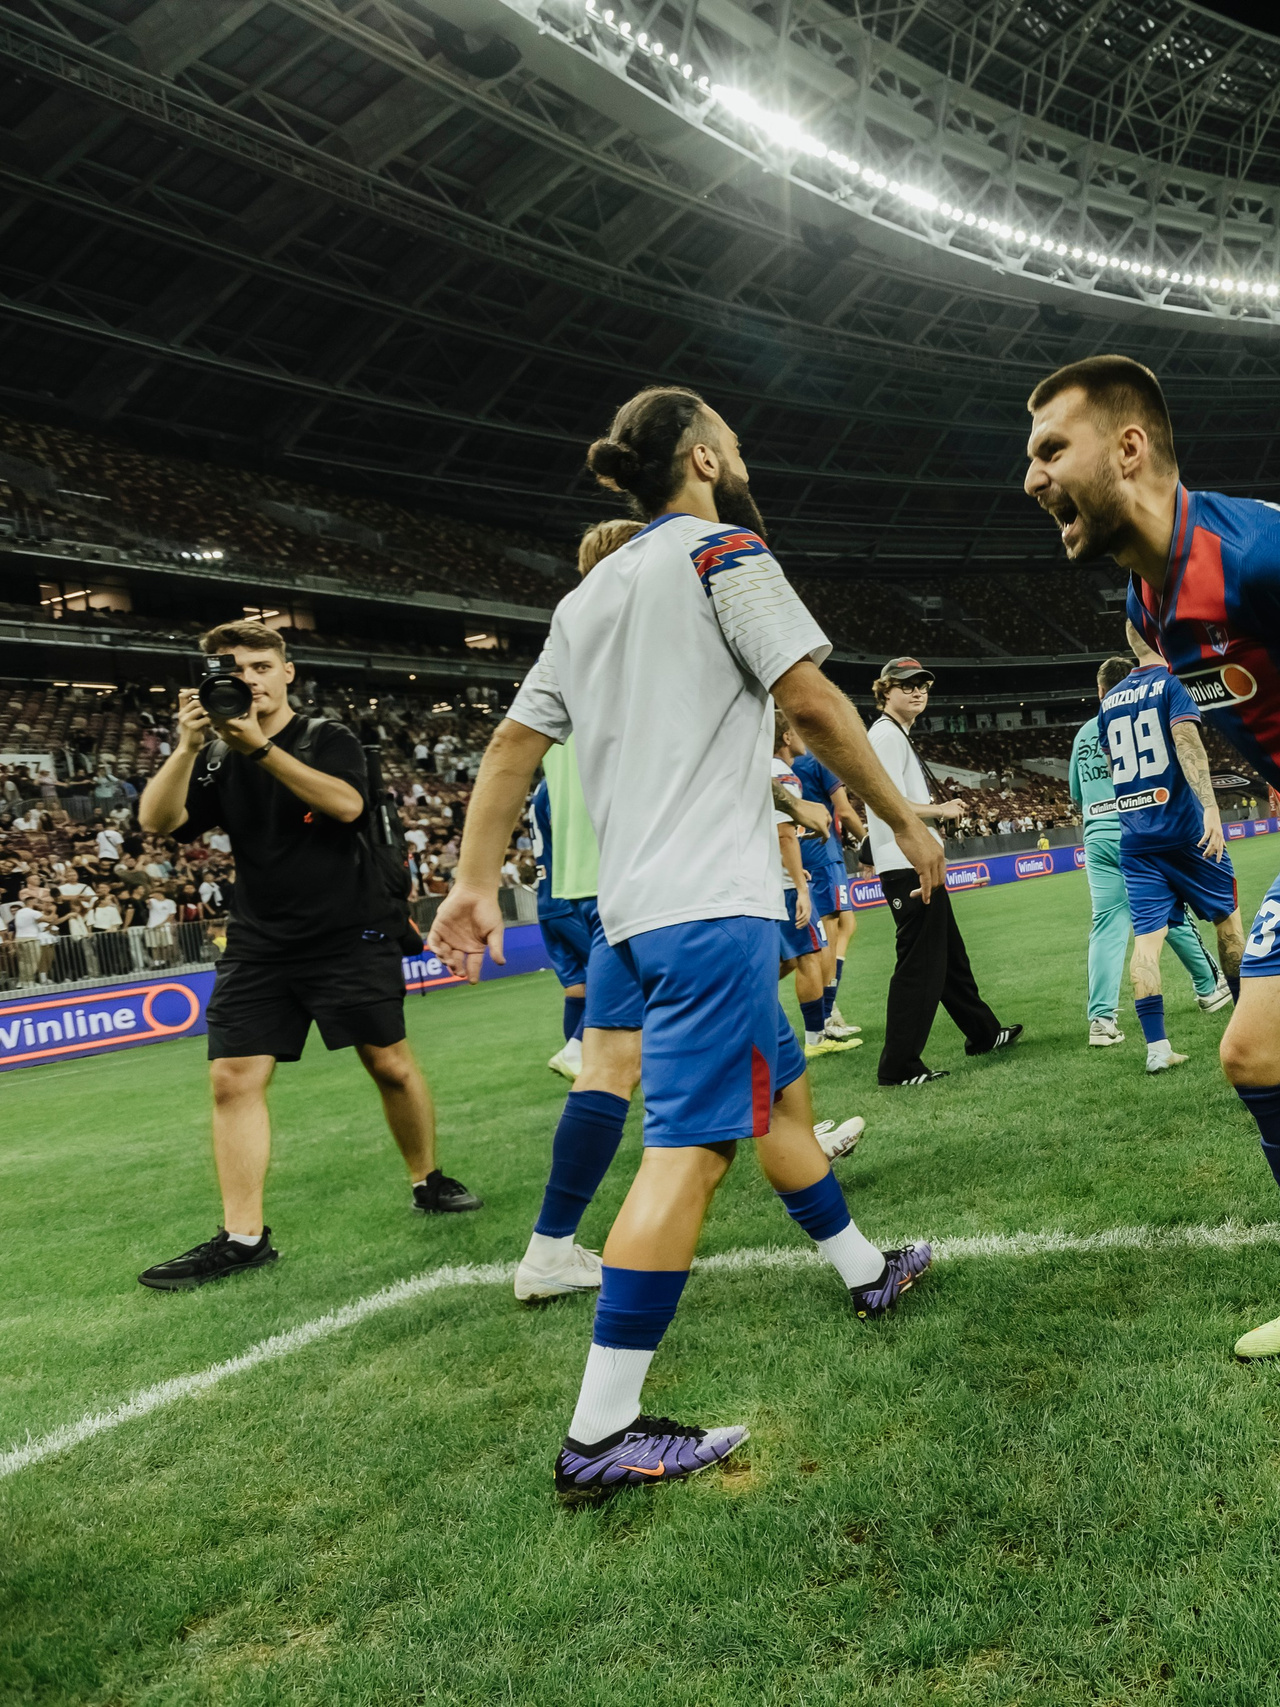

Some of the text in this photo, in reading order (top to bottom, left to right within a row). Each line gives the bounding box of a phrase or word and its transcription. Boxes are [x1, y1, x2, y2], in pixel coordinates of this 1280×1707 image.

[1148, 680, 1166, 698] JR
[1107, 707, 1170, 785] 99
[1080, 763, 1112, 783] Ros
[1120, 795, 1153, 809] Winline
[1018, 859, 1044, 873] Winline
[946, 870, 978, 886] Winline
[854, 883, 885, 901] Winli
